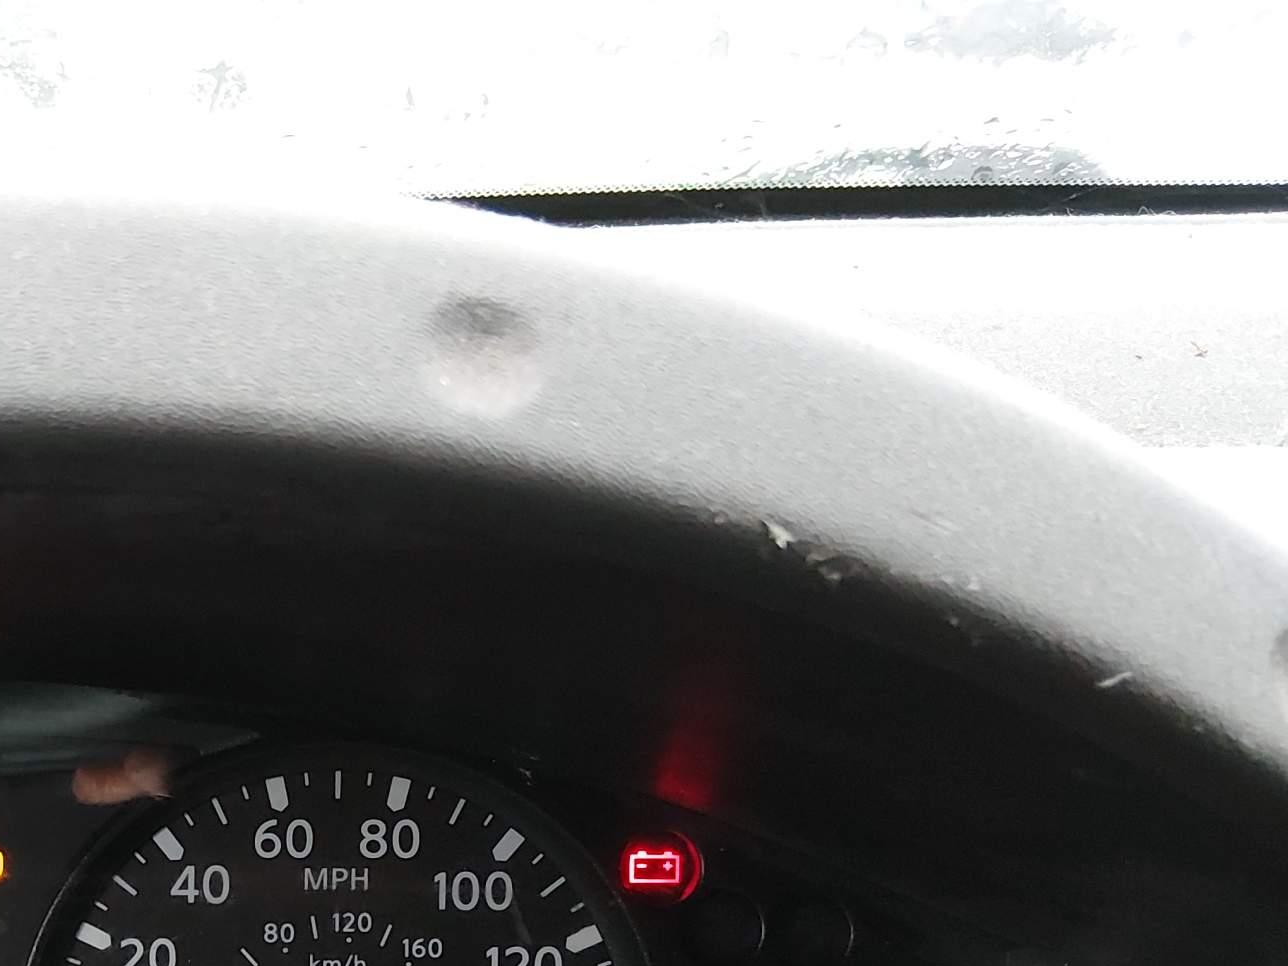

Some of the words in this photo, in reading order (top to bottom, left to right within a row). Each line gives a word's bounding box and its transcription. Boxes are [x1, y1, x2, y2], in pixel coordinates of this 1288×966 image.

[254, 819, 314, 859] 60
[359, 819, 420, 859] 80
[170, 865, 230, 904] 40
[303, 868, 369, 891] MPH
[433, 871, 513, 911] 100
[263, 922, 295, 944] 80
[332, 912, 372, 933] 120
[402, 938, 443, 960] 160
